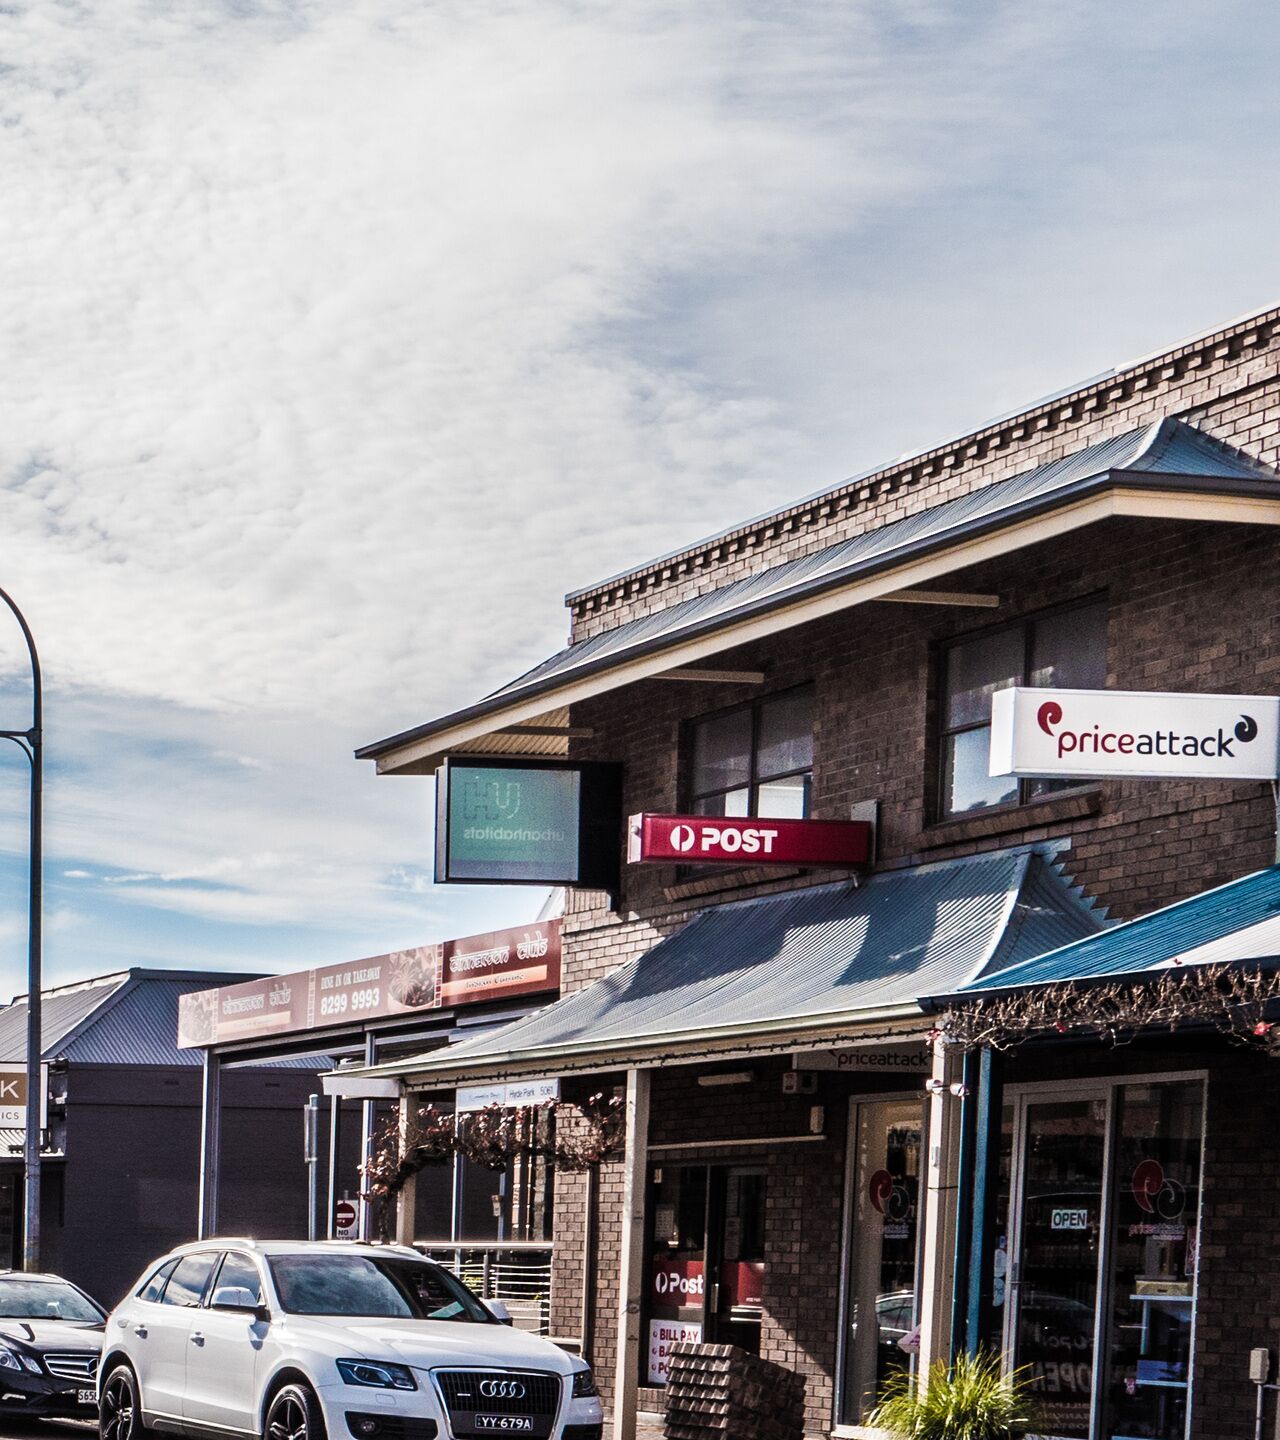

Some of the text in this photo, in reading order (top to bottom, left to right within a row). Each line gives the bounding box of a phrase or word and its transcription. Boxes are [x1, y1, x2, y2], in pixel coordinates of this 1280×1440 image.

[1058, 725, 1235, 759] priceattack
[701, 827, 779, 853] POST
[320, 988, 380, 1016] 8299 9993
[838, 1050, 928, 1069] priceattack
[1053, 1211, 1086, 1226] OPEN
[669, 1272, 704, 1294] Post
[659, 1328, 699, 1342] BILL PAY
